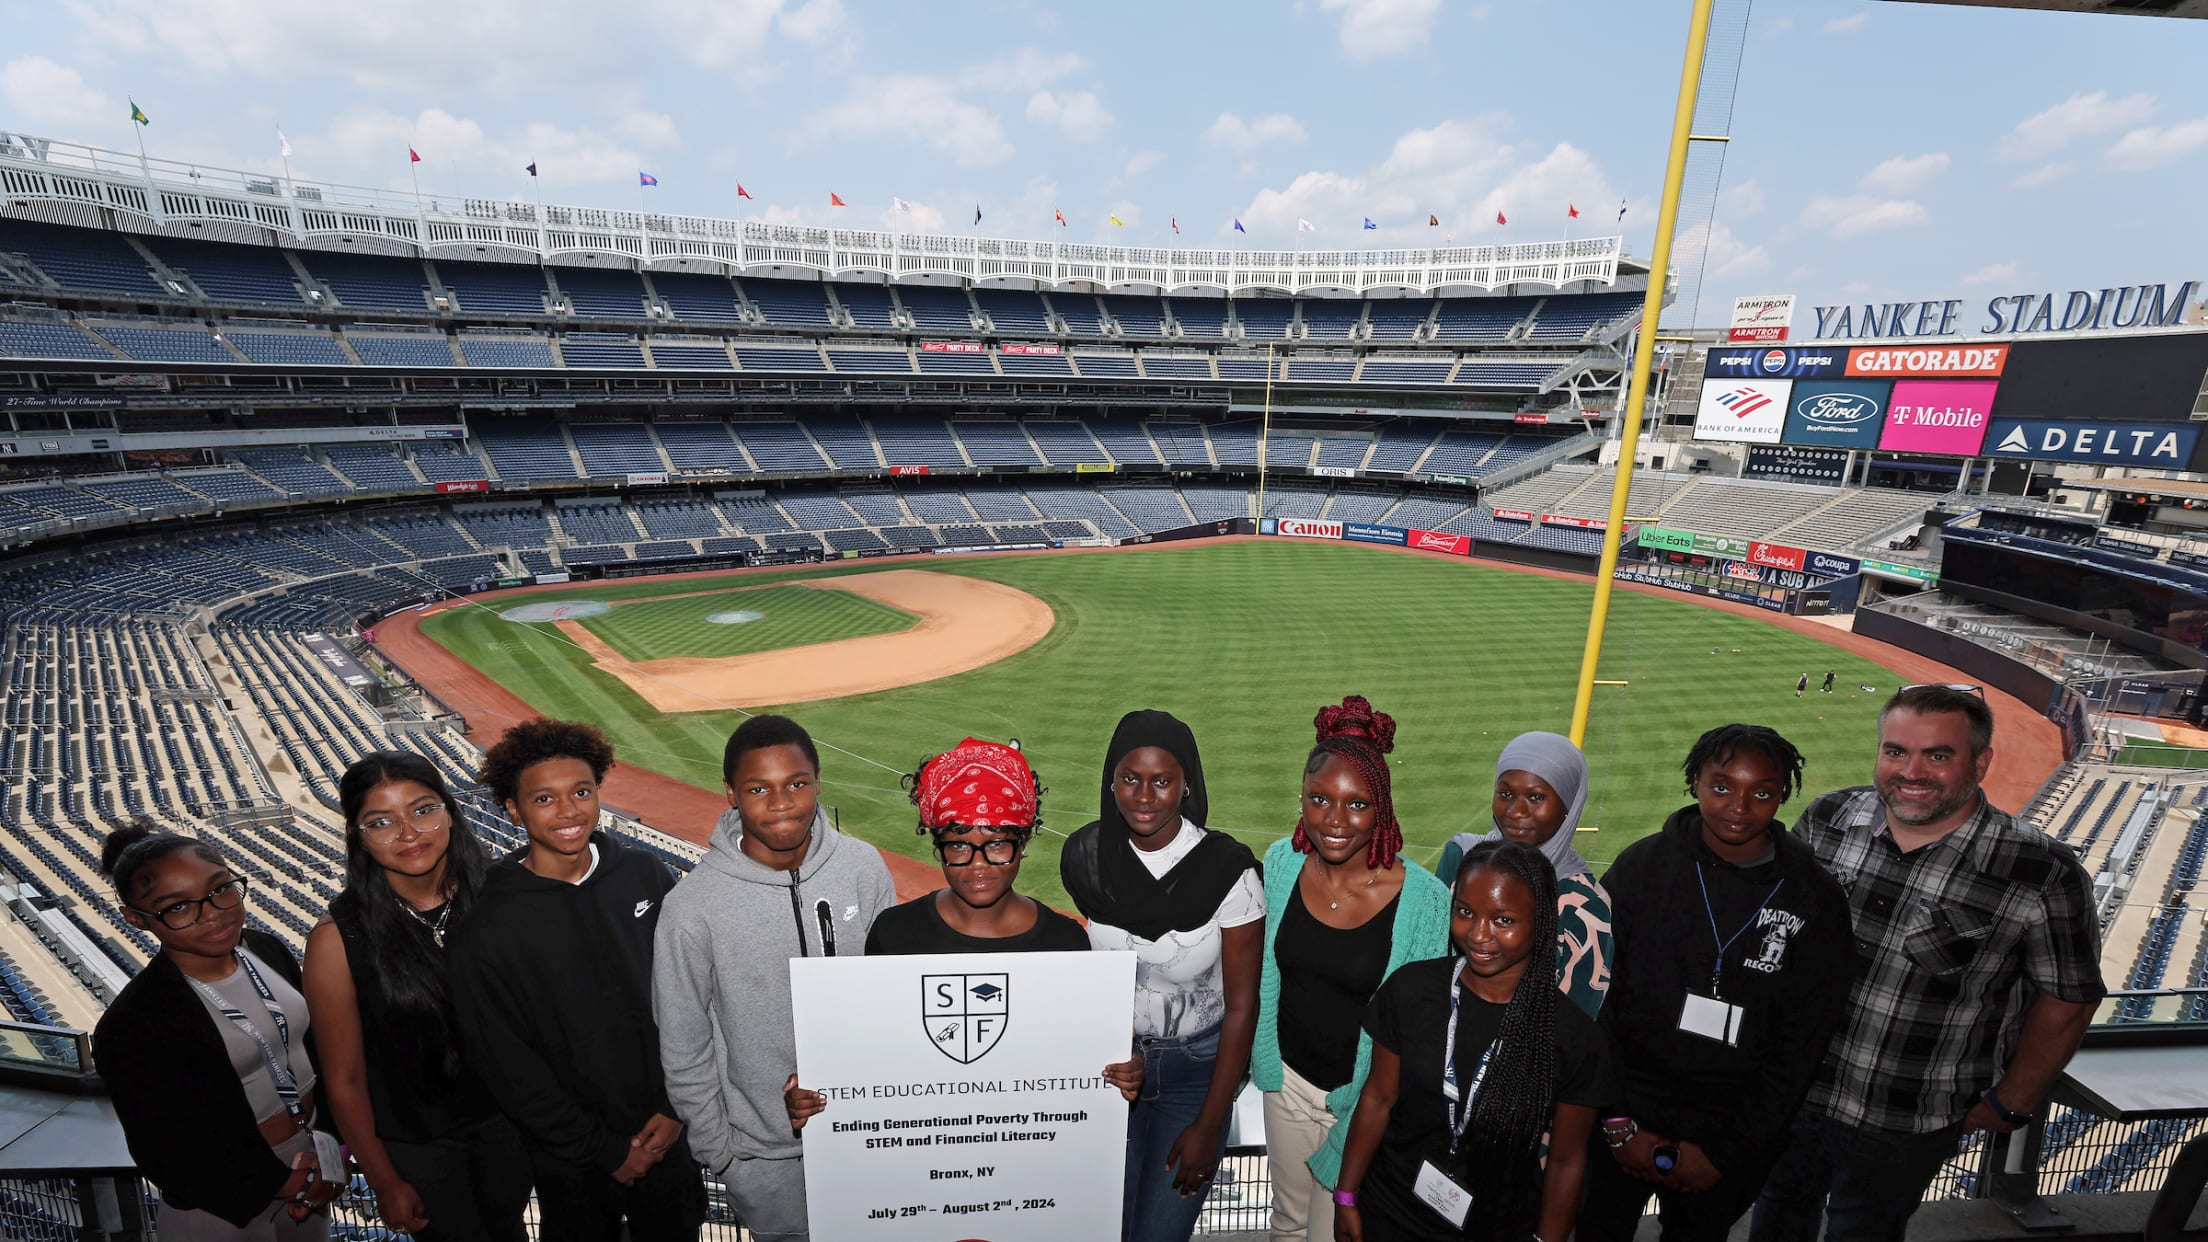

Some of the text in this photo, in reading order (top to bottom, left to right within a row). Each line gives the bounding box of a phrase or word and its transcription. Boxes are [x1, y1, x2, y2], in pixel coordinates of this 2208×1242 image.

[1737, 300, 1790, 309] ARMITRON
[1813, 281, 2202, 339] YANKEE STADIUM
[1734, 328, 1780, 336] ARMITRON
[1720, 357, 1752, 366] PEPSI
[1798, 357, 1832, 366] PEPSI
[1855, 348, 2003, 371] GATORADE
[6, 397, 122, 409] 27-Time World Champions
[1810, 397, 1864, 419] Ford
[1912, 406, 1983, 428] Mobile
[1697, 424, 1780, 435] BANK OF AMERICA
[2041, 428, 2179, 458] DELTA
[899, 466, 920, 475] AVIS
[1321, 468, 1347, 476] ORIS
[1280, 520, 1341, 536] Canon
[1641, 531, 1665, 543] Uber
[1666, 535, 1691, 547] Eats
[1825, 559, 1850, 571] coupa
[1664, 580, 1692, 591] StubHub
[1768, 569, 1777, 584] A
[1779, 571, 1803, 588] SUB
[250, 968, 270, 997] YANKEES
[201, 983, 226, 1008] YANKEES
[936, 983, 954, 1008] S
[977, 1019, 994, 1043] F
[254, 1030, 265, 1047] NEW
[270, 1055, 287, 1084] YANKEES
[817, 1077, 1112, 1100] STEM EDUCATIONAL INSTITUTE
[832, 1110, 1088, 1133] Ending Generational Poverty Through
[866, 1130, 1056, 1149] STEM and Financial Literacy
[929, 1166, 995, 1180] Bronx, NY
[868, 1207, 897, 1220] July
[900, 1204, 927, 1217] 29th
[942, 1202, 990, 1215] August
[992, 1199, 1012, 1211] 2nd
[1022, 1198, 1056, 1210] 2024
